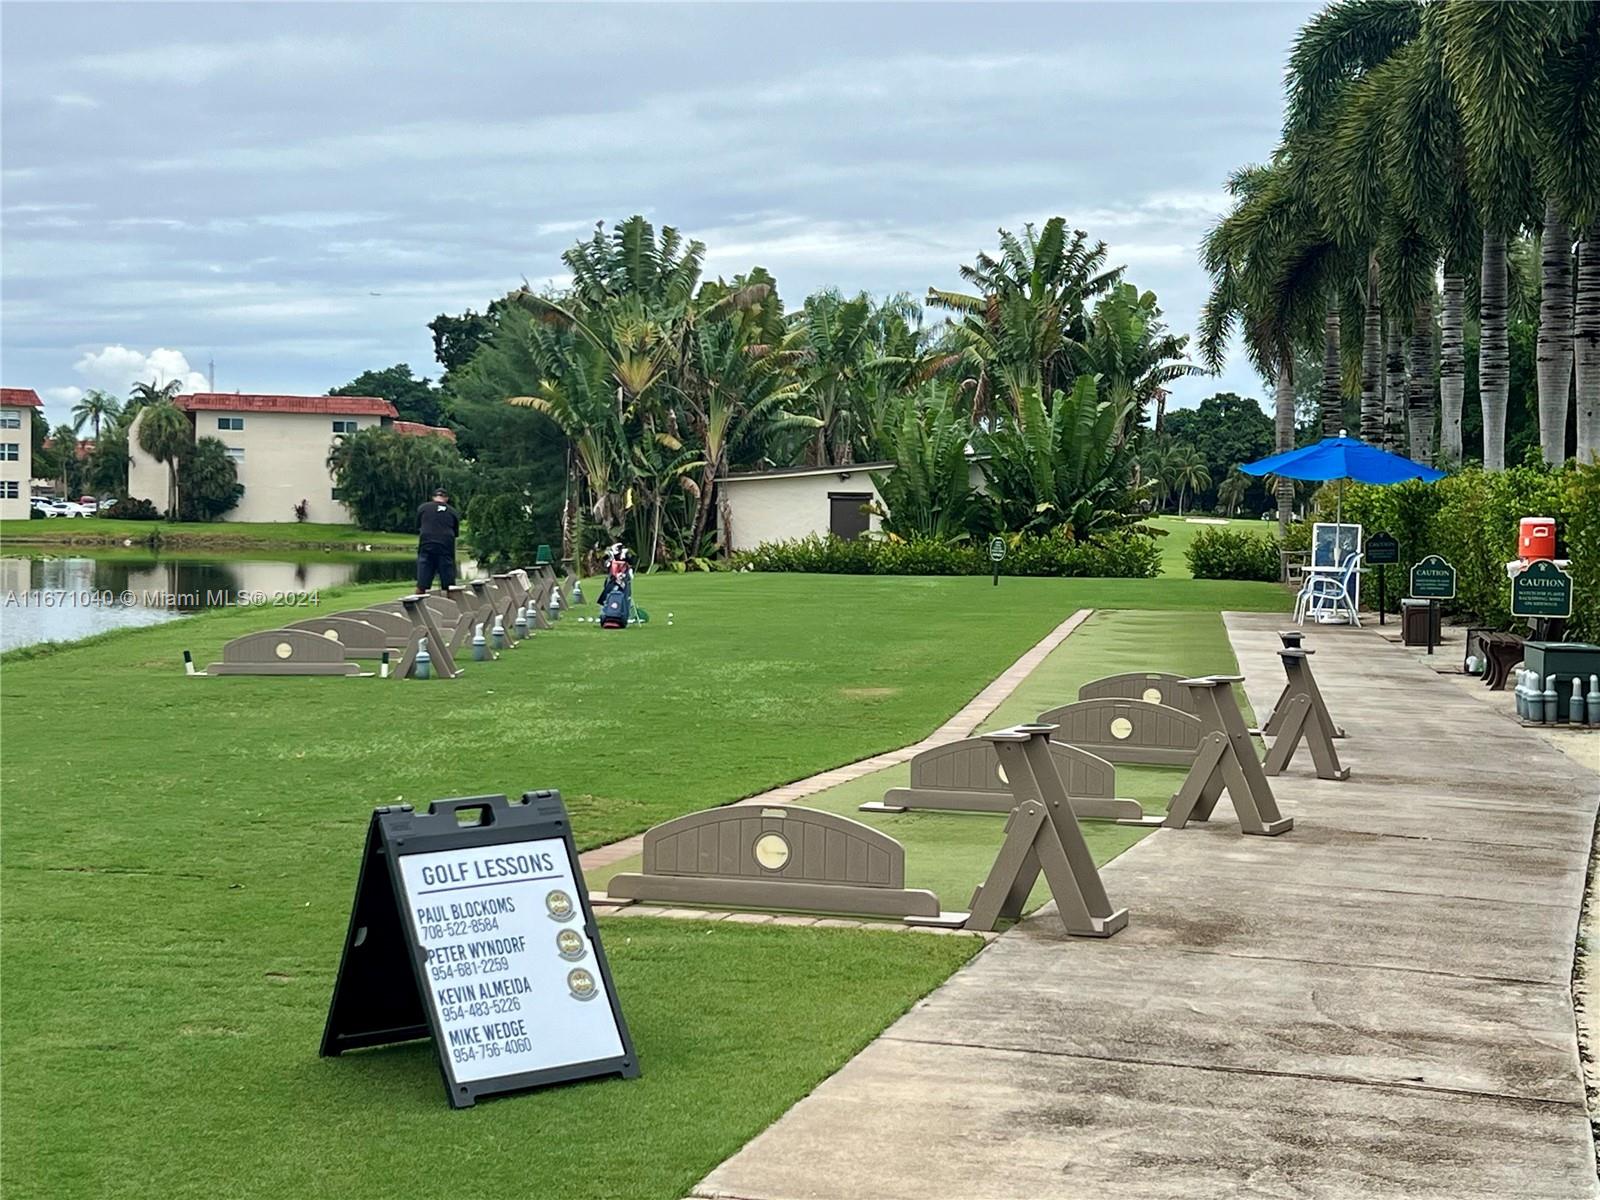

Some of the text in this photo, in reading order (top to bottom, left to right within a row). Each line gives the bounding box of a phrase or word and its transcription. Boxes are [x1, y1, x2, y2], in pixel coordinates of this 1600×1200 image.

[1416, 569, 1450, 577] CAUTION
[1519, 578, 1565, 587] CAUTION
[422, 853, 554, 886] GOLF LESSONS
[417, 896, 516, 925] PAUL BLOCKOMS
[421, 917, 499, 940] 708-522-8584
[428, 936, 526, 966] PETER WYNDORF
[431, 956, 509, 981] 954-681-2259
[437, 976, 533, 1006] KEVIN ALMEIDA
[442, 996, 521, 1022] 954-483-5226
[448, 1019, 528, 1047] MIKE WEDGE
[453, 1037, 533, 1063] 954-756-4060
